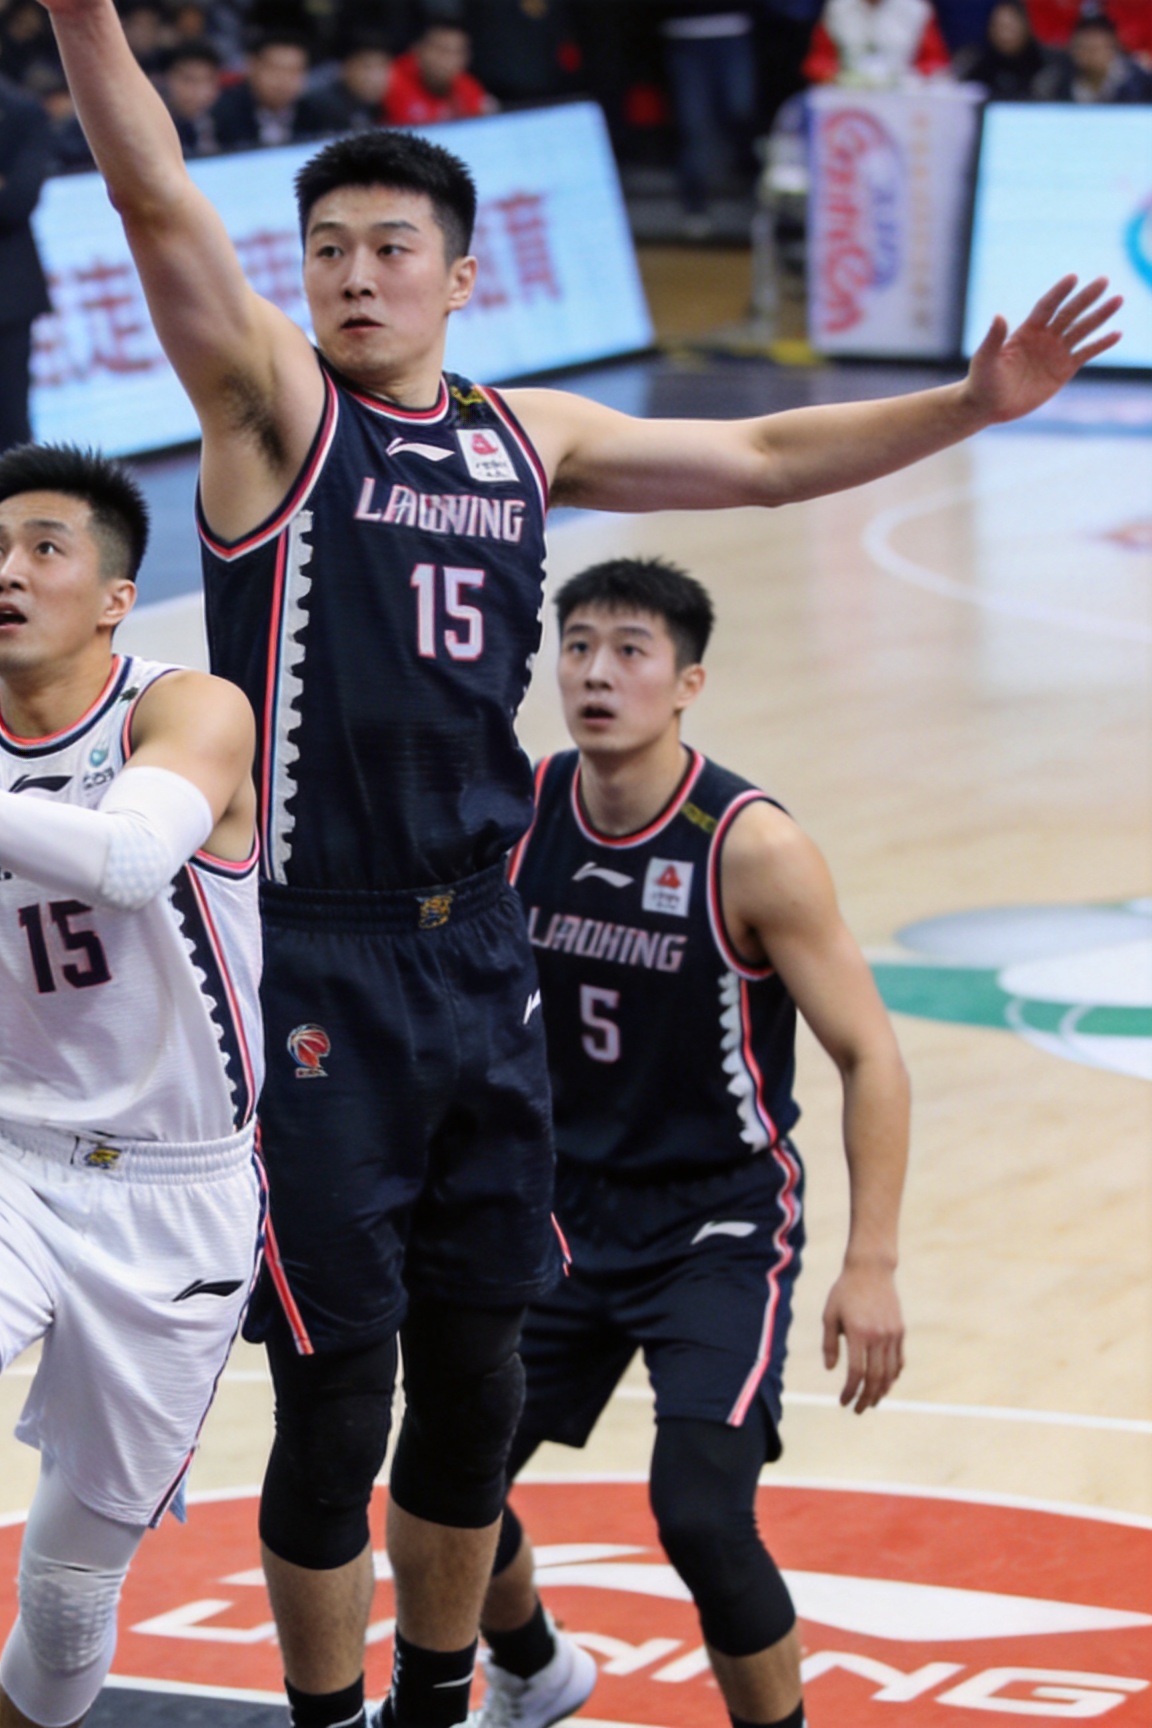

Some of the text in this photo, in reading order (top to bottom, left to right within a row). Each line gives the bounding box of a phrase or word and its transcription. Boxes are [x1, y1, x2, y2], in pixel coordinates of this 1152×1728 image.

[410, 563, 486, 661] 15
[17, 899, 113, 994] 15
[579, 983, 621, 1064] 5
